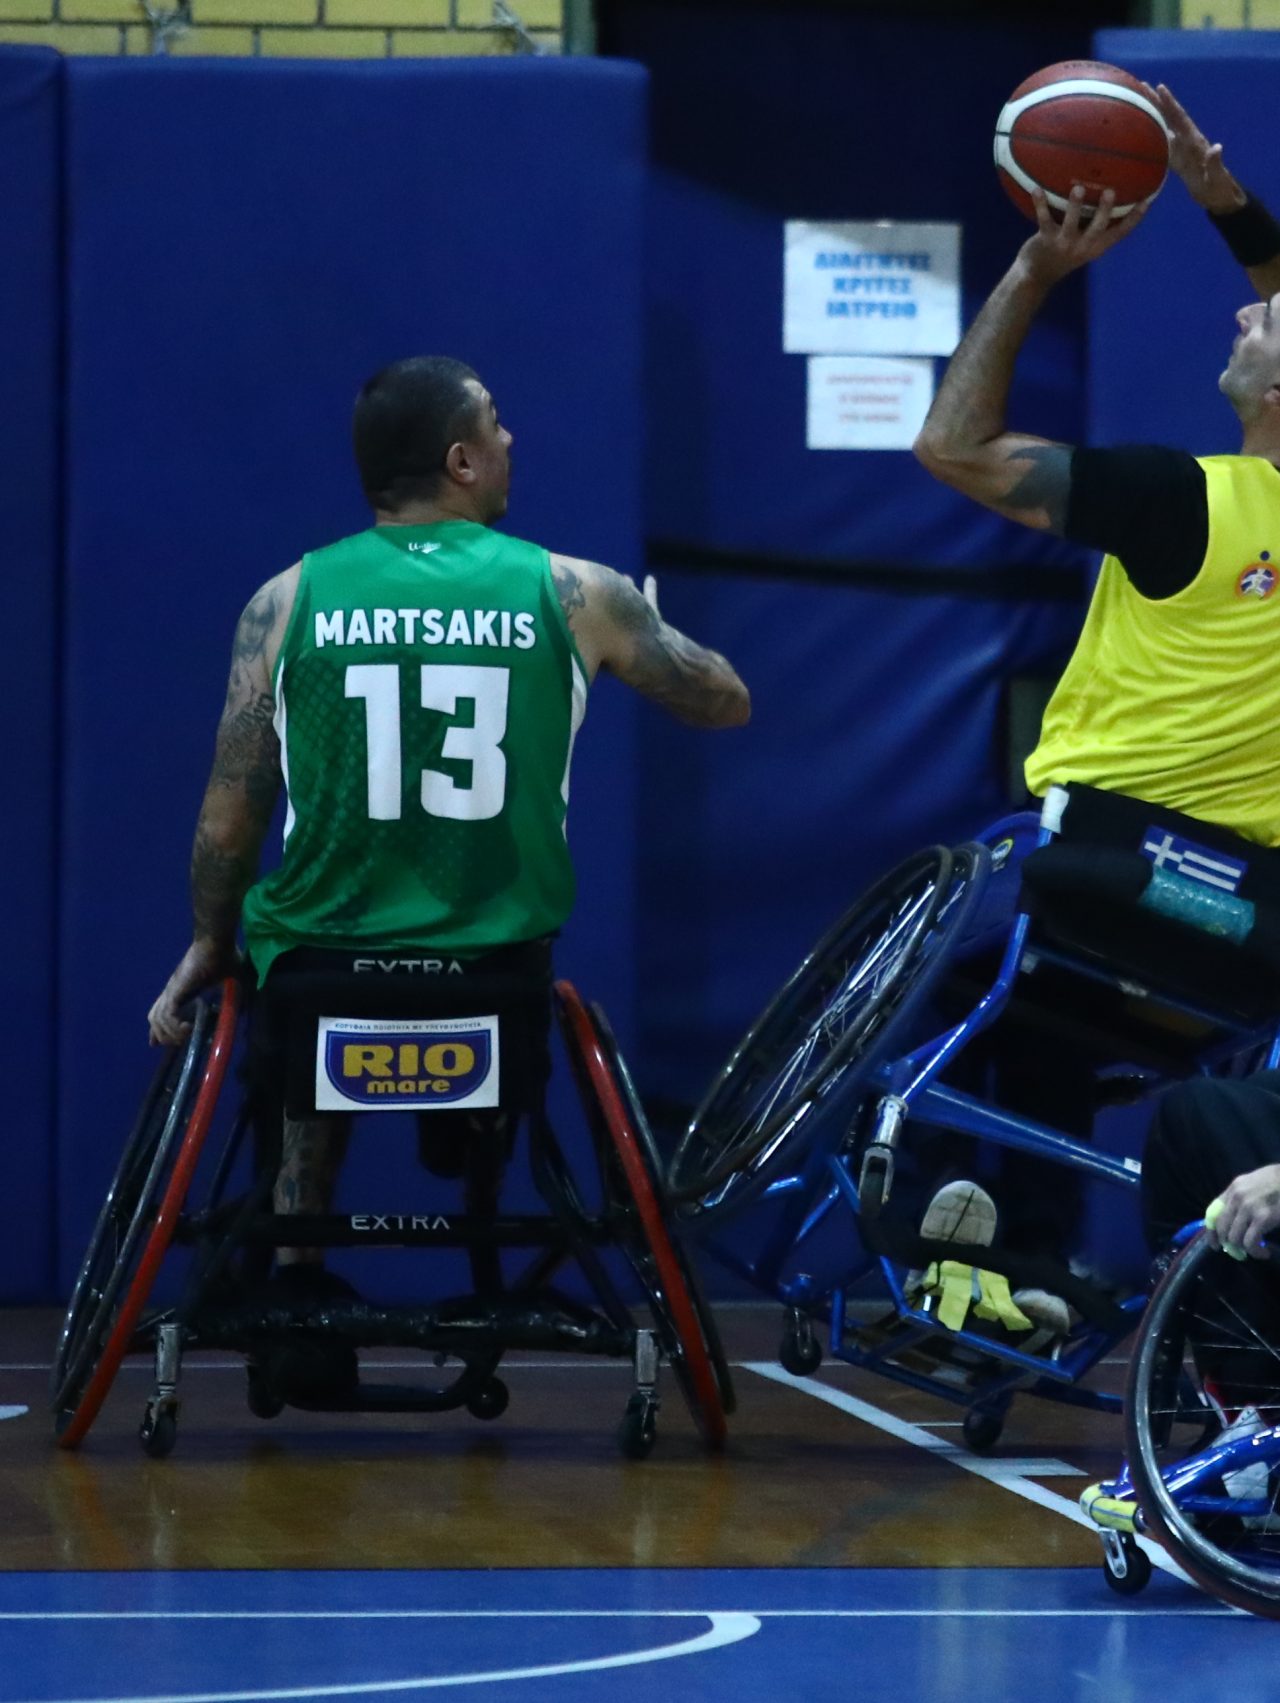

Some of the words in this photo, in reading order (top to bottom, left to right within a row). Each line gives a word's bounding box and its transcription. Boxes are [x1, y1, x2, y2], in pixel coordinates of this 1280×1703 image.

[315, 608, 536, 650] MARTSAKIS
[344, 664, 510, 821] 13
[343, 1043, 475, 1078] RIO
[366, 1079, 450, 1094] mare
[351, 1215, 450, 1230] EXTRA
